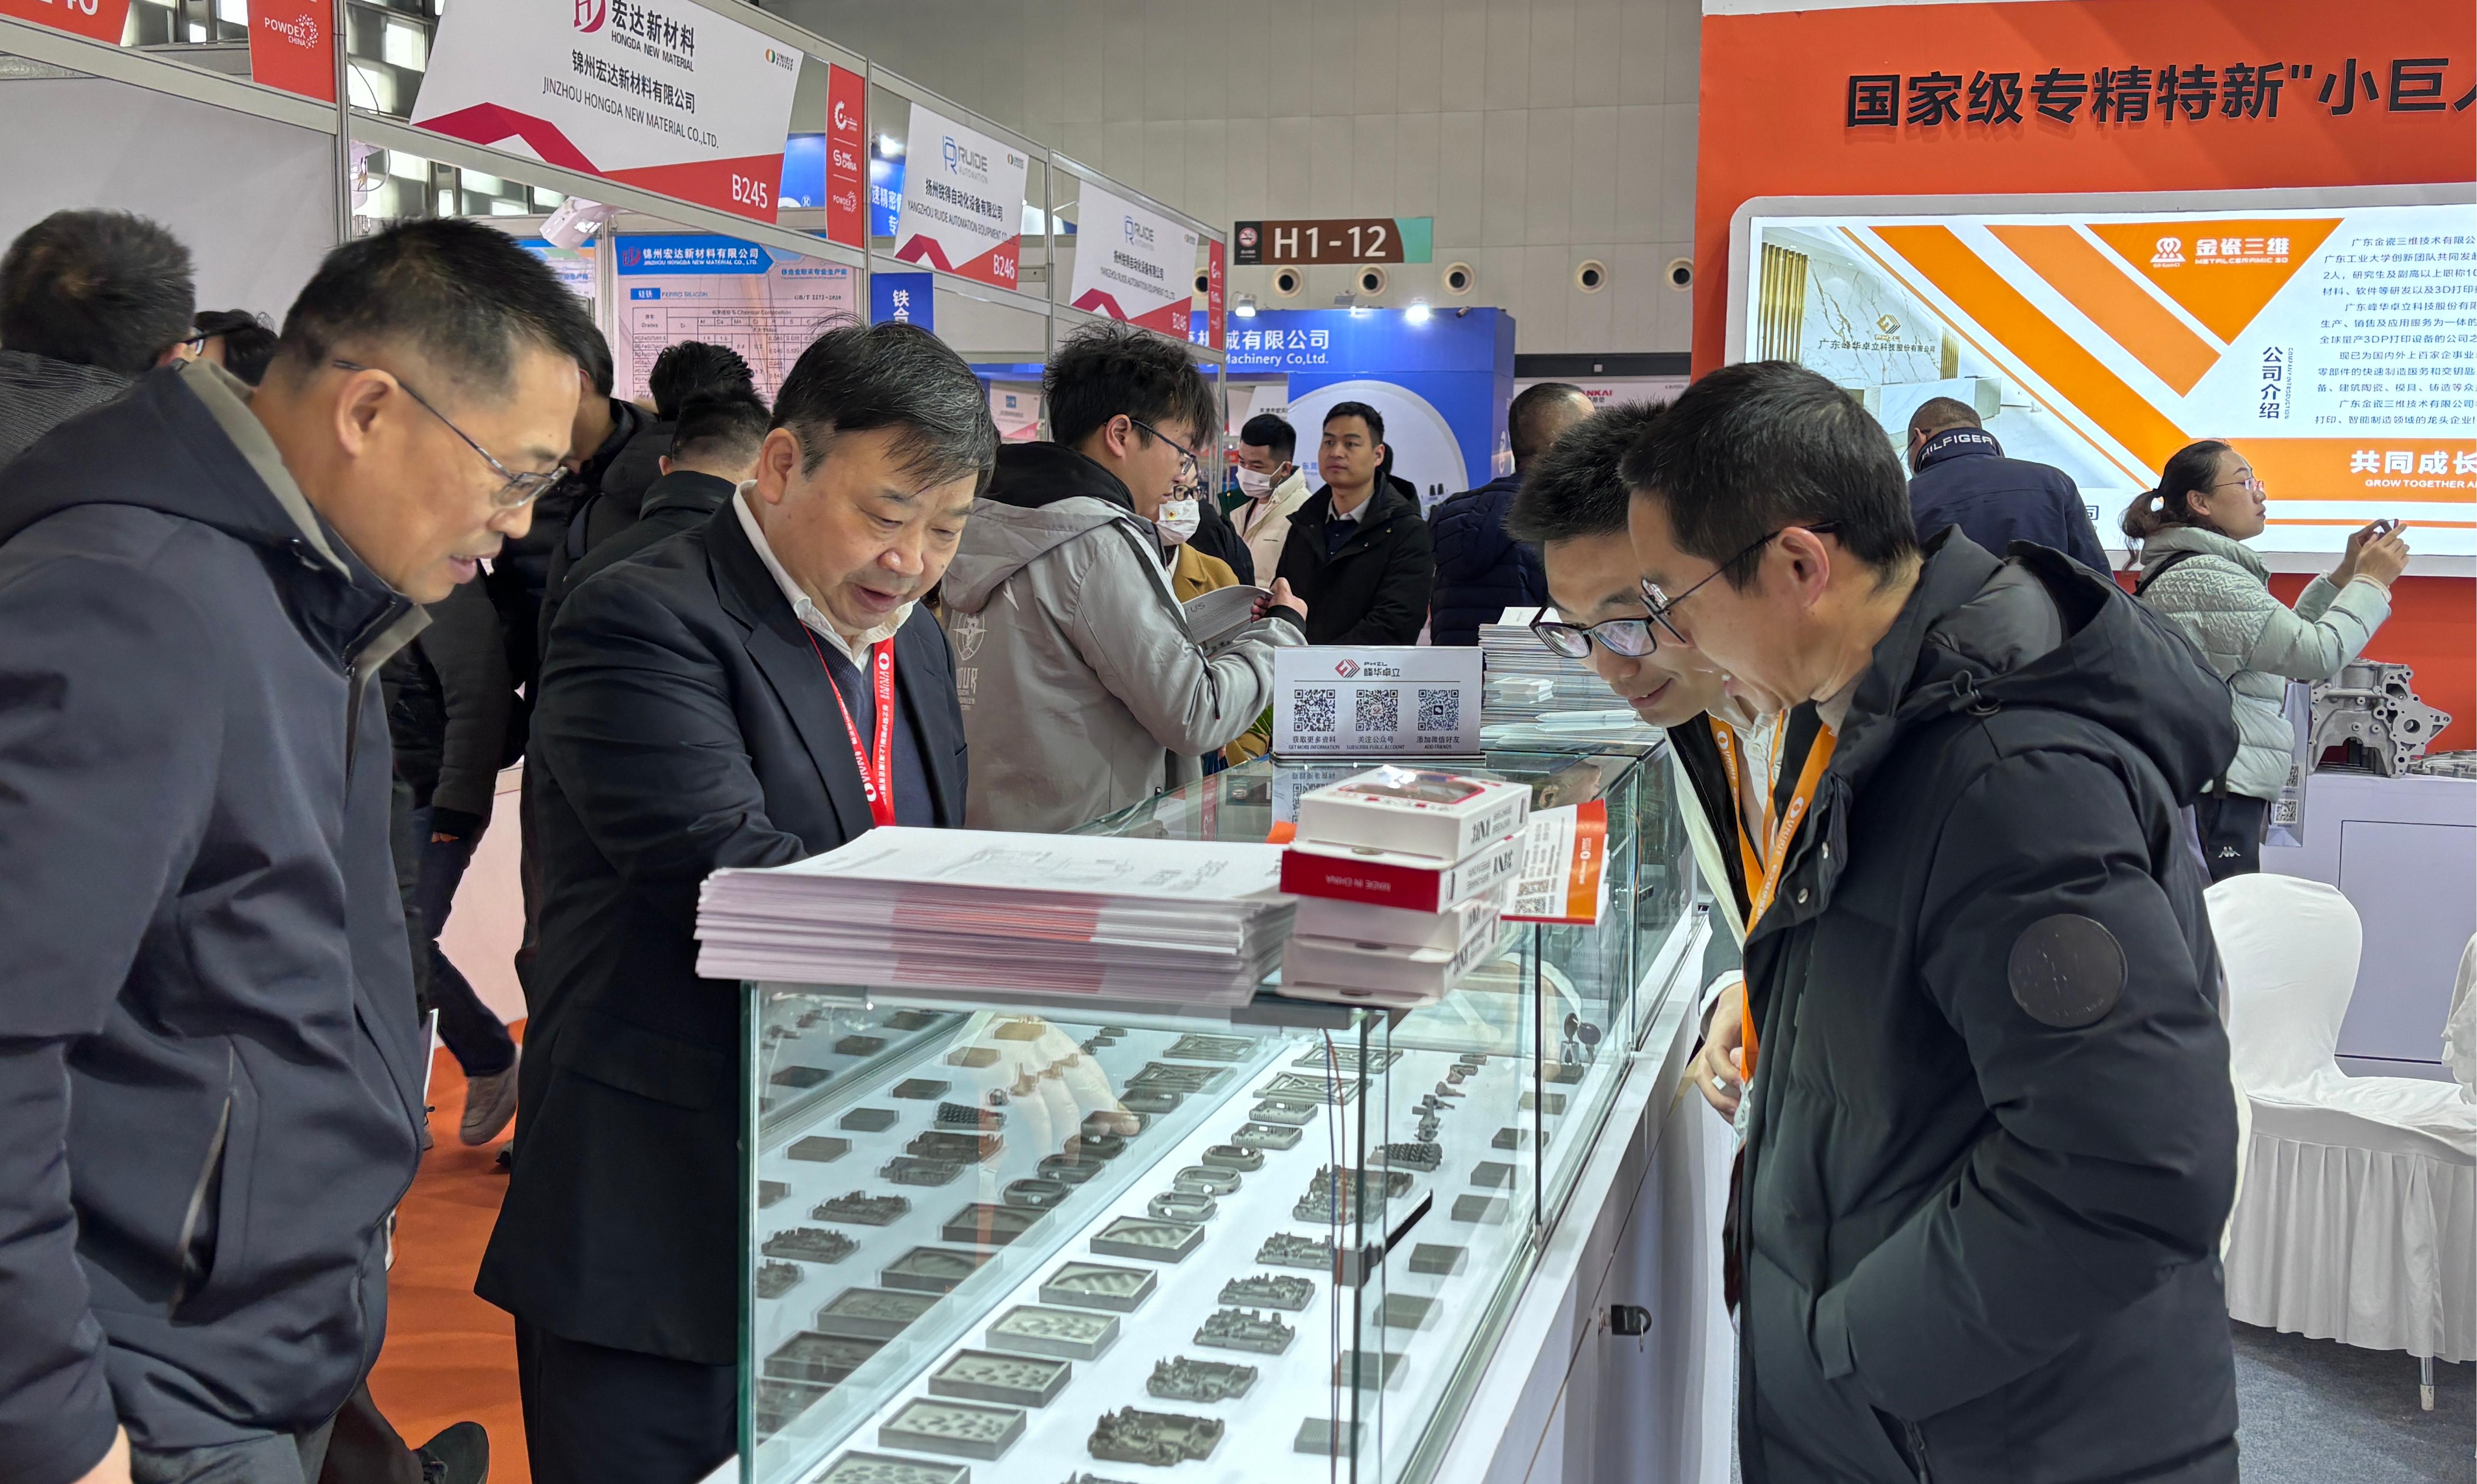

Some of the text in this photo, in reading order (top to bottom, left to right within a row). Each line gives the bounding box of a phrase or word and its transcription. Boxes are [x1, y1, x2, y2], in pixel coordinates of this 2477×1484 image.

[265, 17, 305, 39] POWDEX
[612, 0, 694, 57] 宏达新材料
[288, 36, 306, 47] CHINA
[612, 30, 694, 72] HONGDA NEW MATERIAL
[572, 49, 695, 114] 锦州宏达新材料有限公司
[543, 77, 719, 148] JINZHOU HONGDA NEW MATERIAL CO.,LTD.
[958, 146, 987, 172] RUIDE
[732, 174, 768, 209] B245
[833, 194, 851, 206] POWDEX
[908, 199, 934, 218] YANGZHOU
[934, 207, 948, 223] RUIDE
[948, 213, 977, 233] AUTOMATION
[1274, 226, 1387, 258] H1-12
[2196, 238, 2289, 256] 金瓷三维
[643, 248, 758, 259] 锦州宏达新材料有限公司
[993, 254, 1015, 279] B246
[2323, 285, 2477, 296] 材料、软件等研发以及3D打印
[2340, 351, 2477, 360] 现已为国内外上百家企事业
[2259, 346, 2283, 419] 公司介绍
[2317, 383, 2477, 392] 备、建筑陶瓷、模具、铸造等众
[2340, 399, 2477, 409] 广东金瓷三维技术有限公司
[1921, 434, 1993, 461] HILFIGER
[2350, 450, 2477, 474] 共同成长
[2365, 479, 2402, 487] GROW
[2403, 480, 2465, 488] TOGETHER
[1293, 735, 1336, 744] 获取更多资料
[1358, 735, 1394, 744] 关注公众号
[1416, 735, 1460, 744] 添加微信好友
